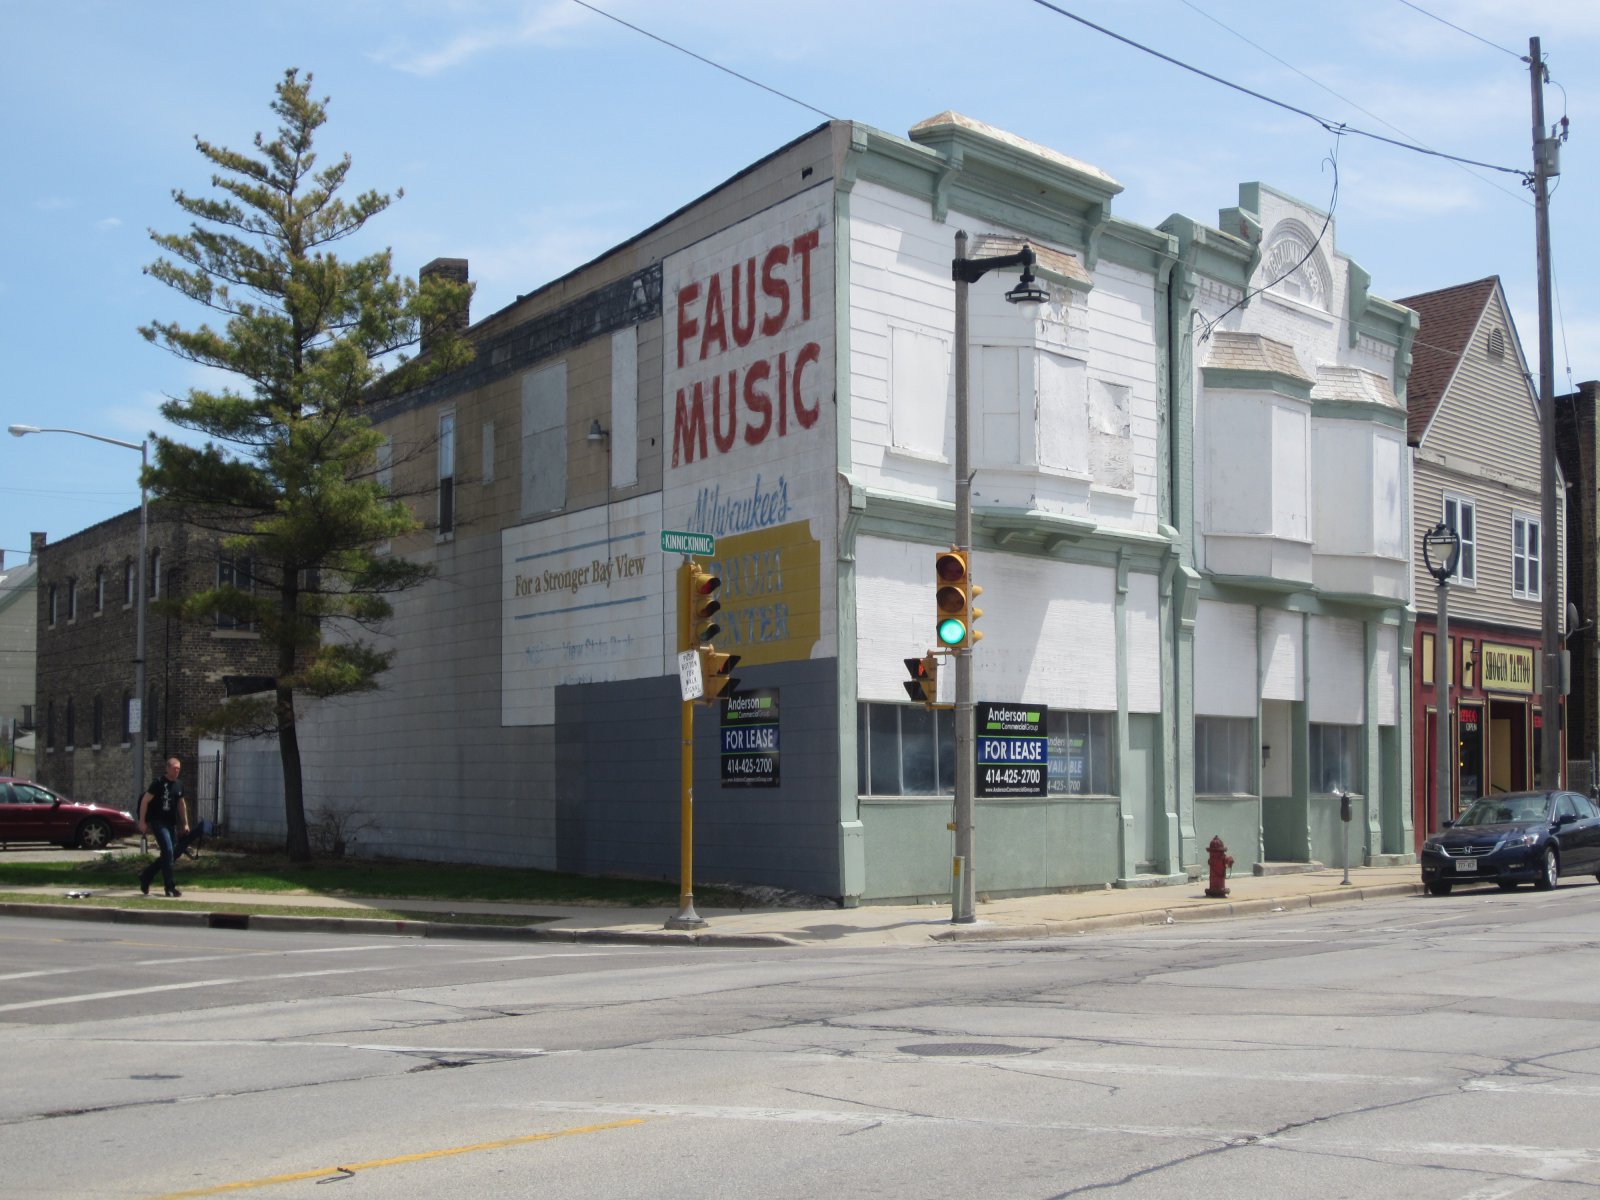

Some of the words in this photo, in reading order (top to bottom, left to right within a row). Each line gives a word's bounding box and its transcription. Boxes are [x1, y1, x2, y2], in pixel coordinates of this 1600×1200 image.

[677, 230, 819, 369] FAUST
[671, 342, 821, 469] MUSIC
[687, 473, 792, 535] Milwaukee's
[665, 534, 711, 553] KINNICKINNIC
[514, 575, 532, 597] For
[535, 577, 542, 593] a
[543, 569, 590, 594] Stronger
[592, 559, 613, 588] Bay
[615, 553, 646, 579] View
[714, 602, 791, 646] ENTER
[1486, 651, 1507, 681] SHOGUN
[1509, 654, 1530, 683] TATTOO
[728, 696, 760, 711] Anderson
[988, 707, 1027, 721] Anderson
[726, 731, 743, 750] FOR
[746, 729, 773, 749] LEASE
[985, 741, 1007, 760] FOR
[1010, 741, 1041, 760] LEASE
[727, 758, 773, 774] 414-425-2700
[985, 769, 1040, 784] 414-425-2700
